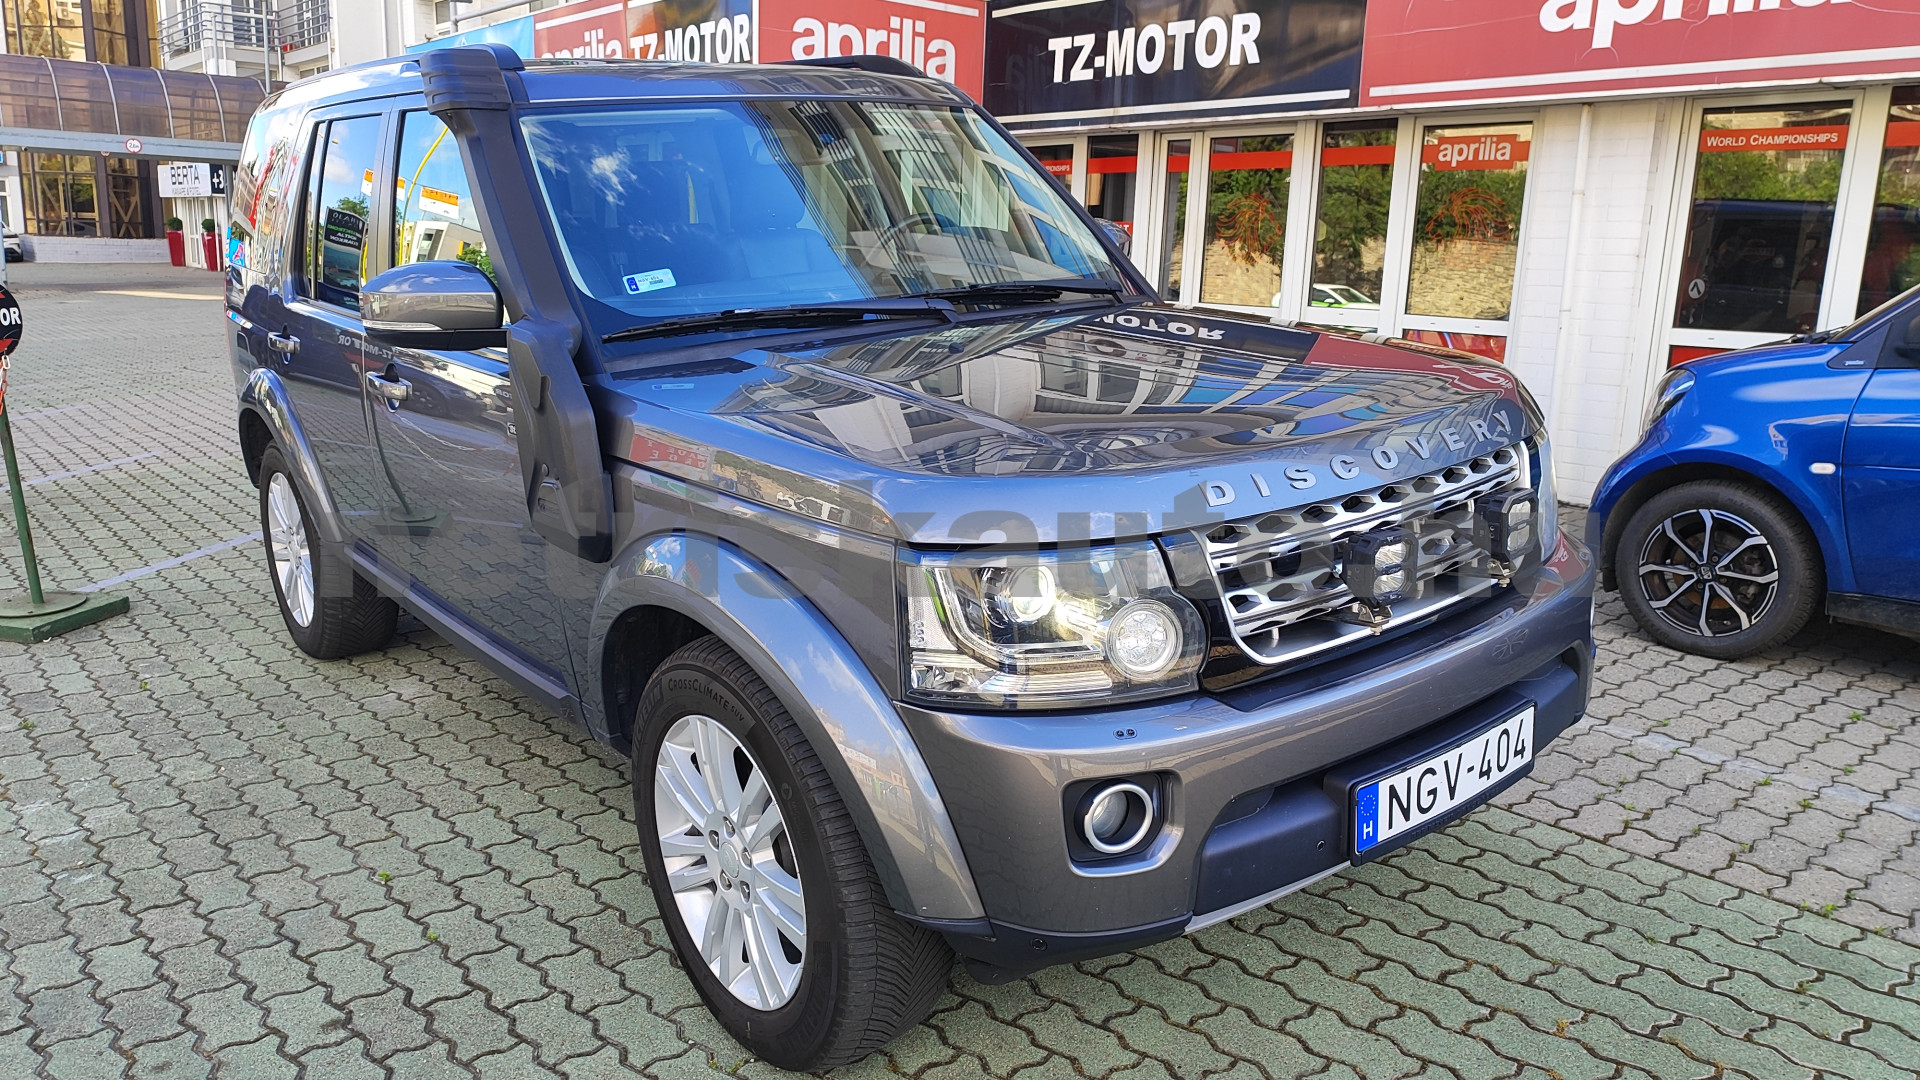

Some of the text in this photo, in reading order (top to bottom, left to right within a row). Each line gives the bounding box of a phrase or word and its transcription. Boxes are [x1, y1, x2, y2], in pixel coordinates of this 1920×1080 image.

[791, 15, 956, 85] aprilia
[1048, 12, 1261, 83] TZ-MOTOR
[170, 164, 201, 186] BERTA
[1438, 136, 1511, 167] aprilia
[1199, 410, 1512, 507] DISCOVERY
[730, 705, 745, 722] SUV
[1387, 718, 1526, 831] NGV-404
[1362, 820, 1373, 840] H
